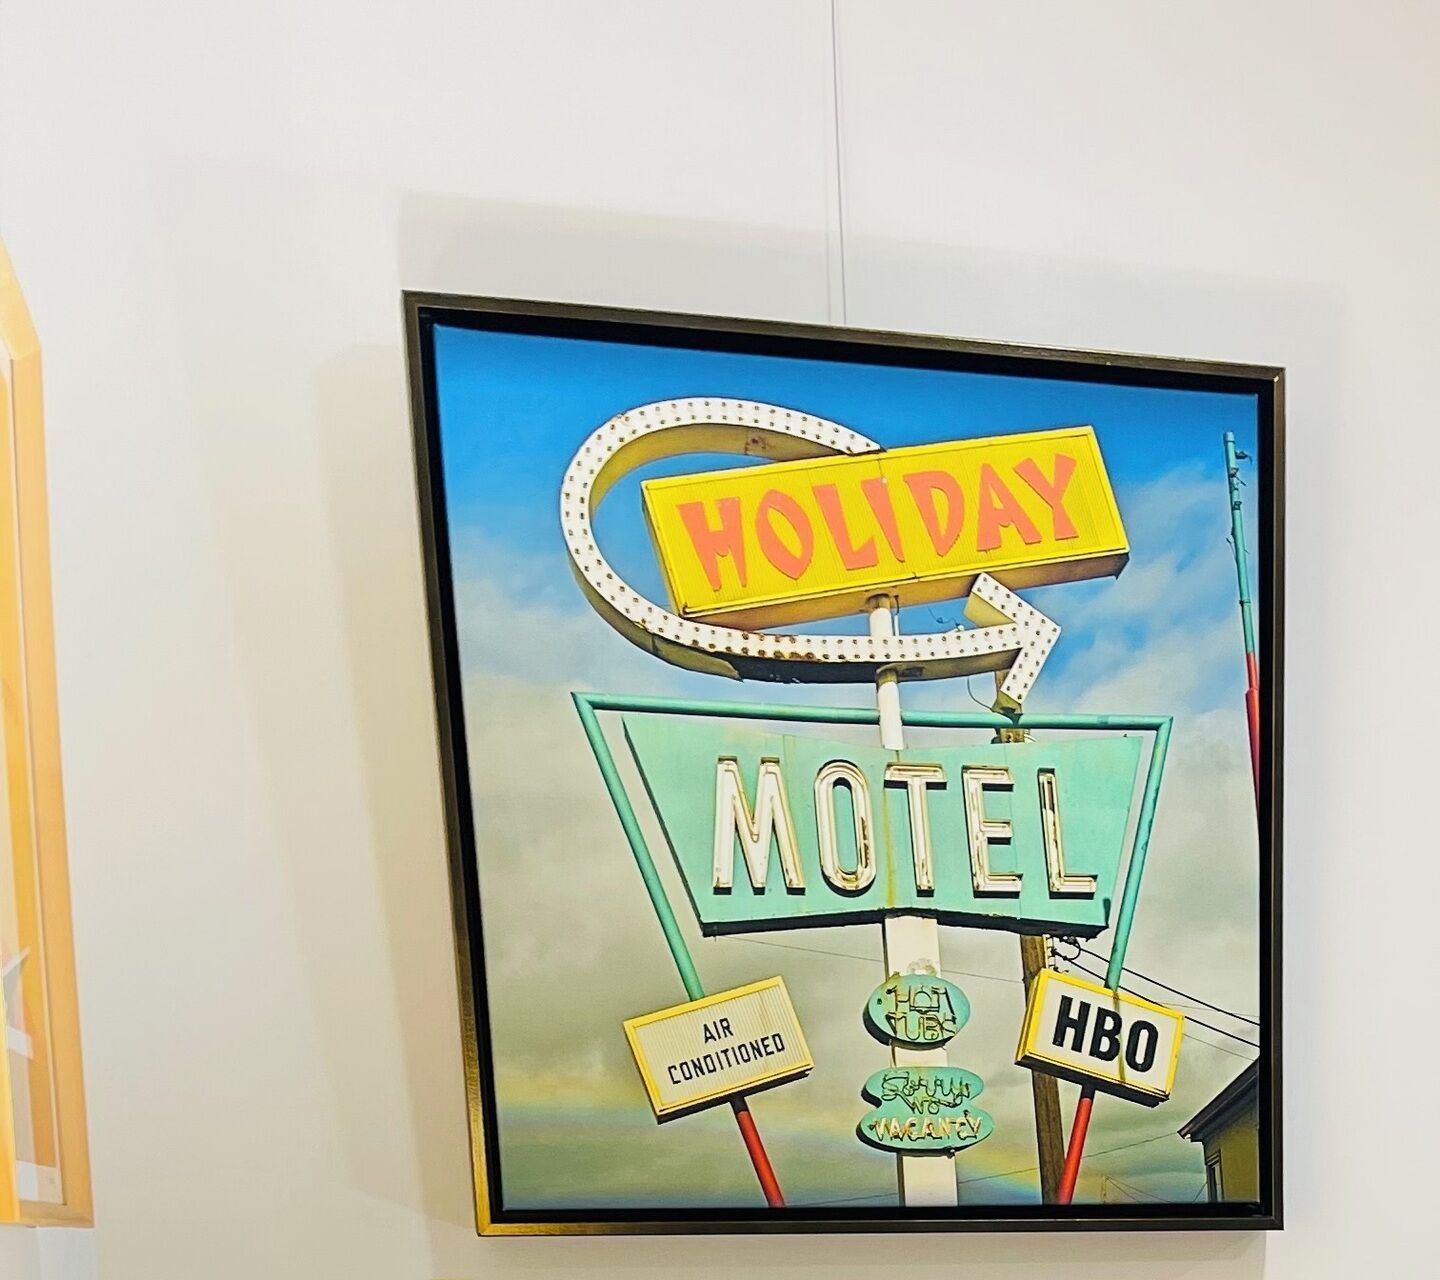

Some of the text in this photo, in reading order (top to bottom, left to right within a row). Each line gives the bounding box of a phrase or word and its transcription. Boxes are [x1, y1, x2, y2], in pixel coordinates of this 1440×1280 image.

[676, 452, 1078, 592] HOLIDAY
[711, 755, 1099, 898] MOTEL
[886, 984, 956, 1015] HOT
[702, 1017, 734, 1044] AIR
[885, 1011, 957, 1042] TUBS
[1052, 994, 1159, 1073] HBO
[667, 1032, 786, 1085] CONDITIONED
[869, 1115, 982, 1142] VACANCY
